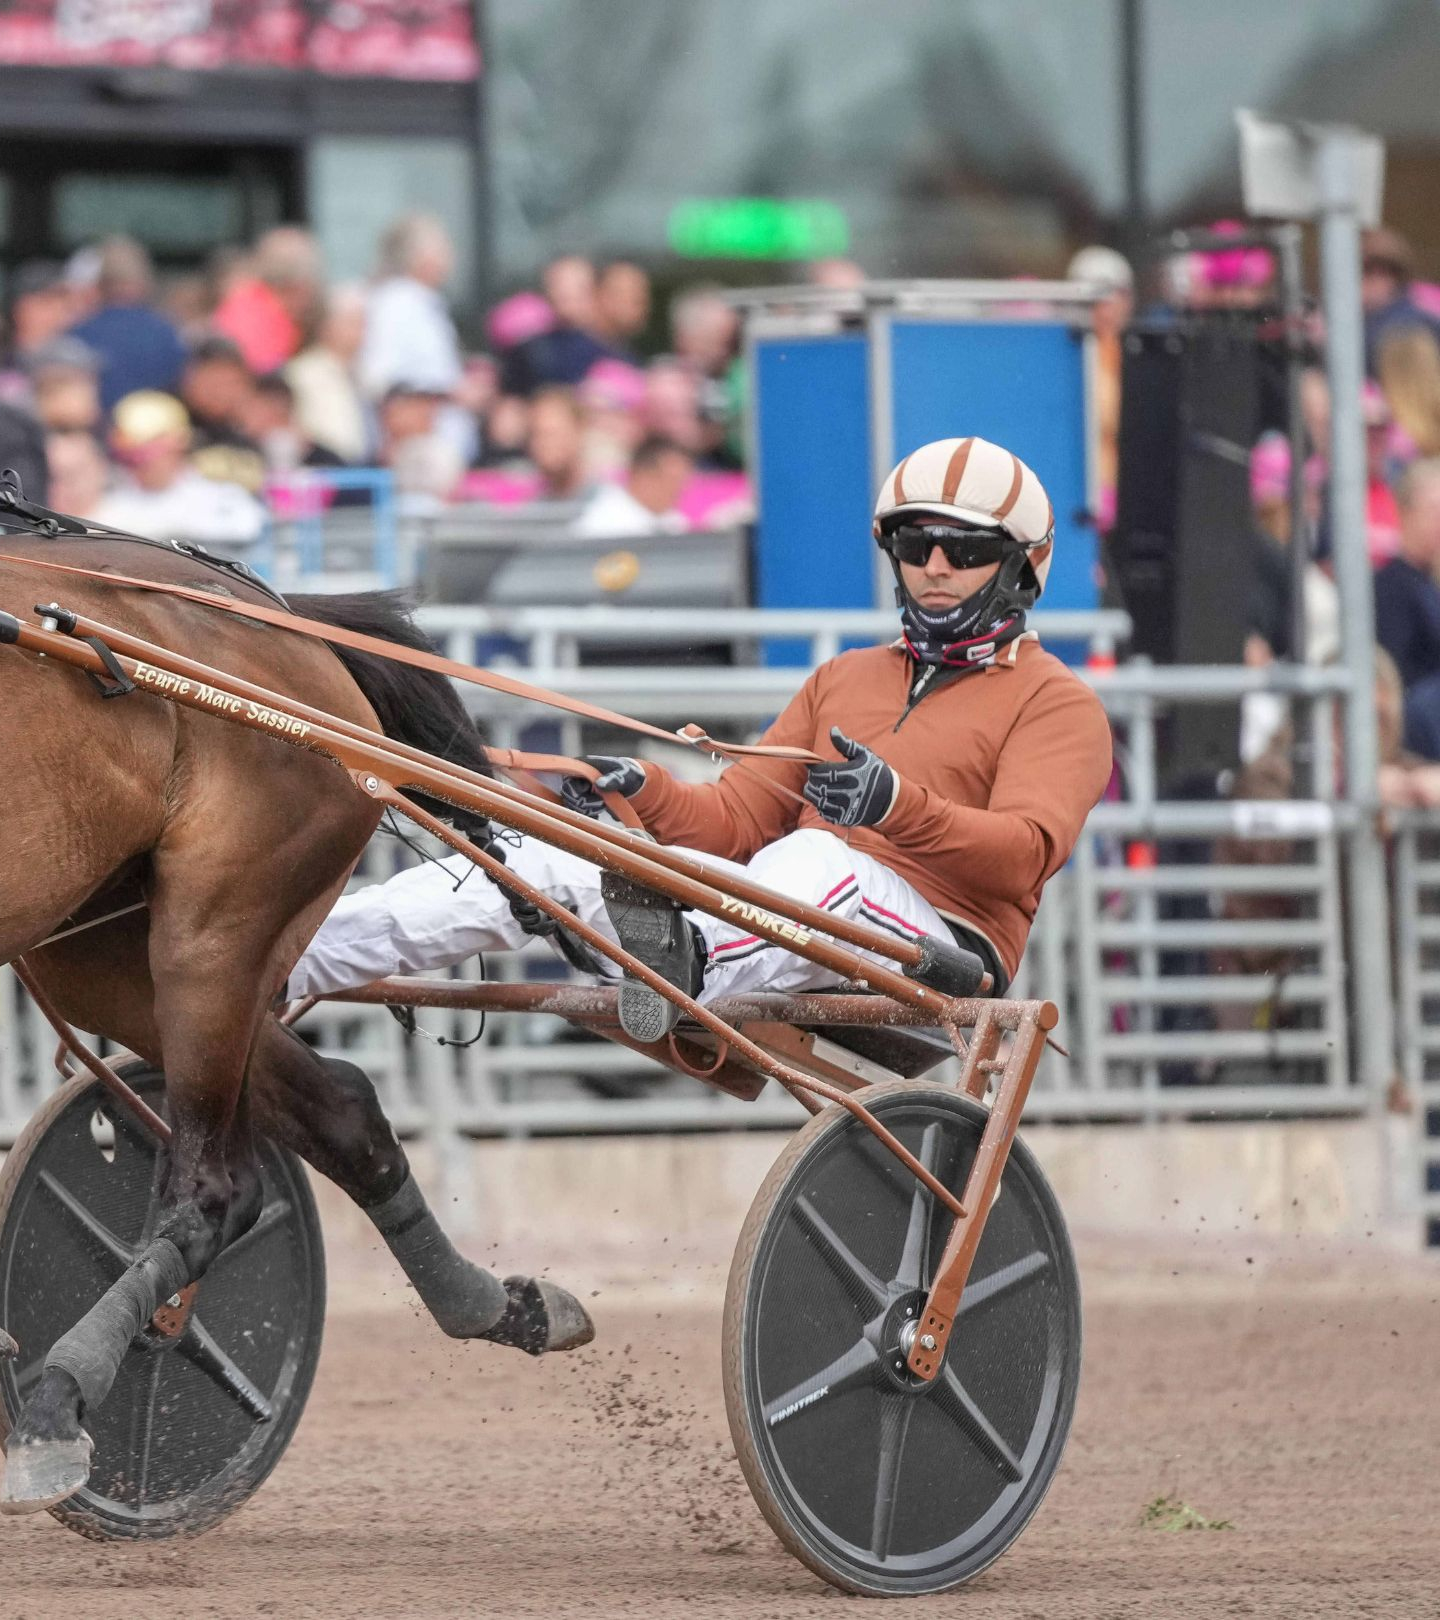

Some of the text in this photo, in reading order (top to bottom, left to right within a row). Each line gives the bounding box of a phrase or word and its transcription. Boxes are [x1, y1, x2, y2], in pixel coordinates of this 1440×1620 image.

[133, 662, 310, 738] Ecurie Marc Sassier
[720, 893, 812, 946] YANKEE
[770, 1384, 829, 1427] FINNTREK
